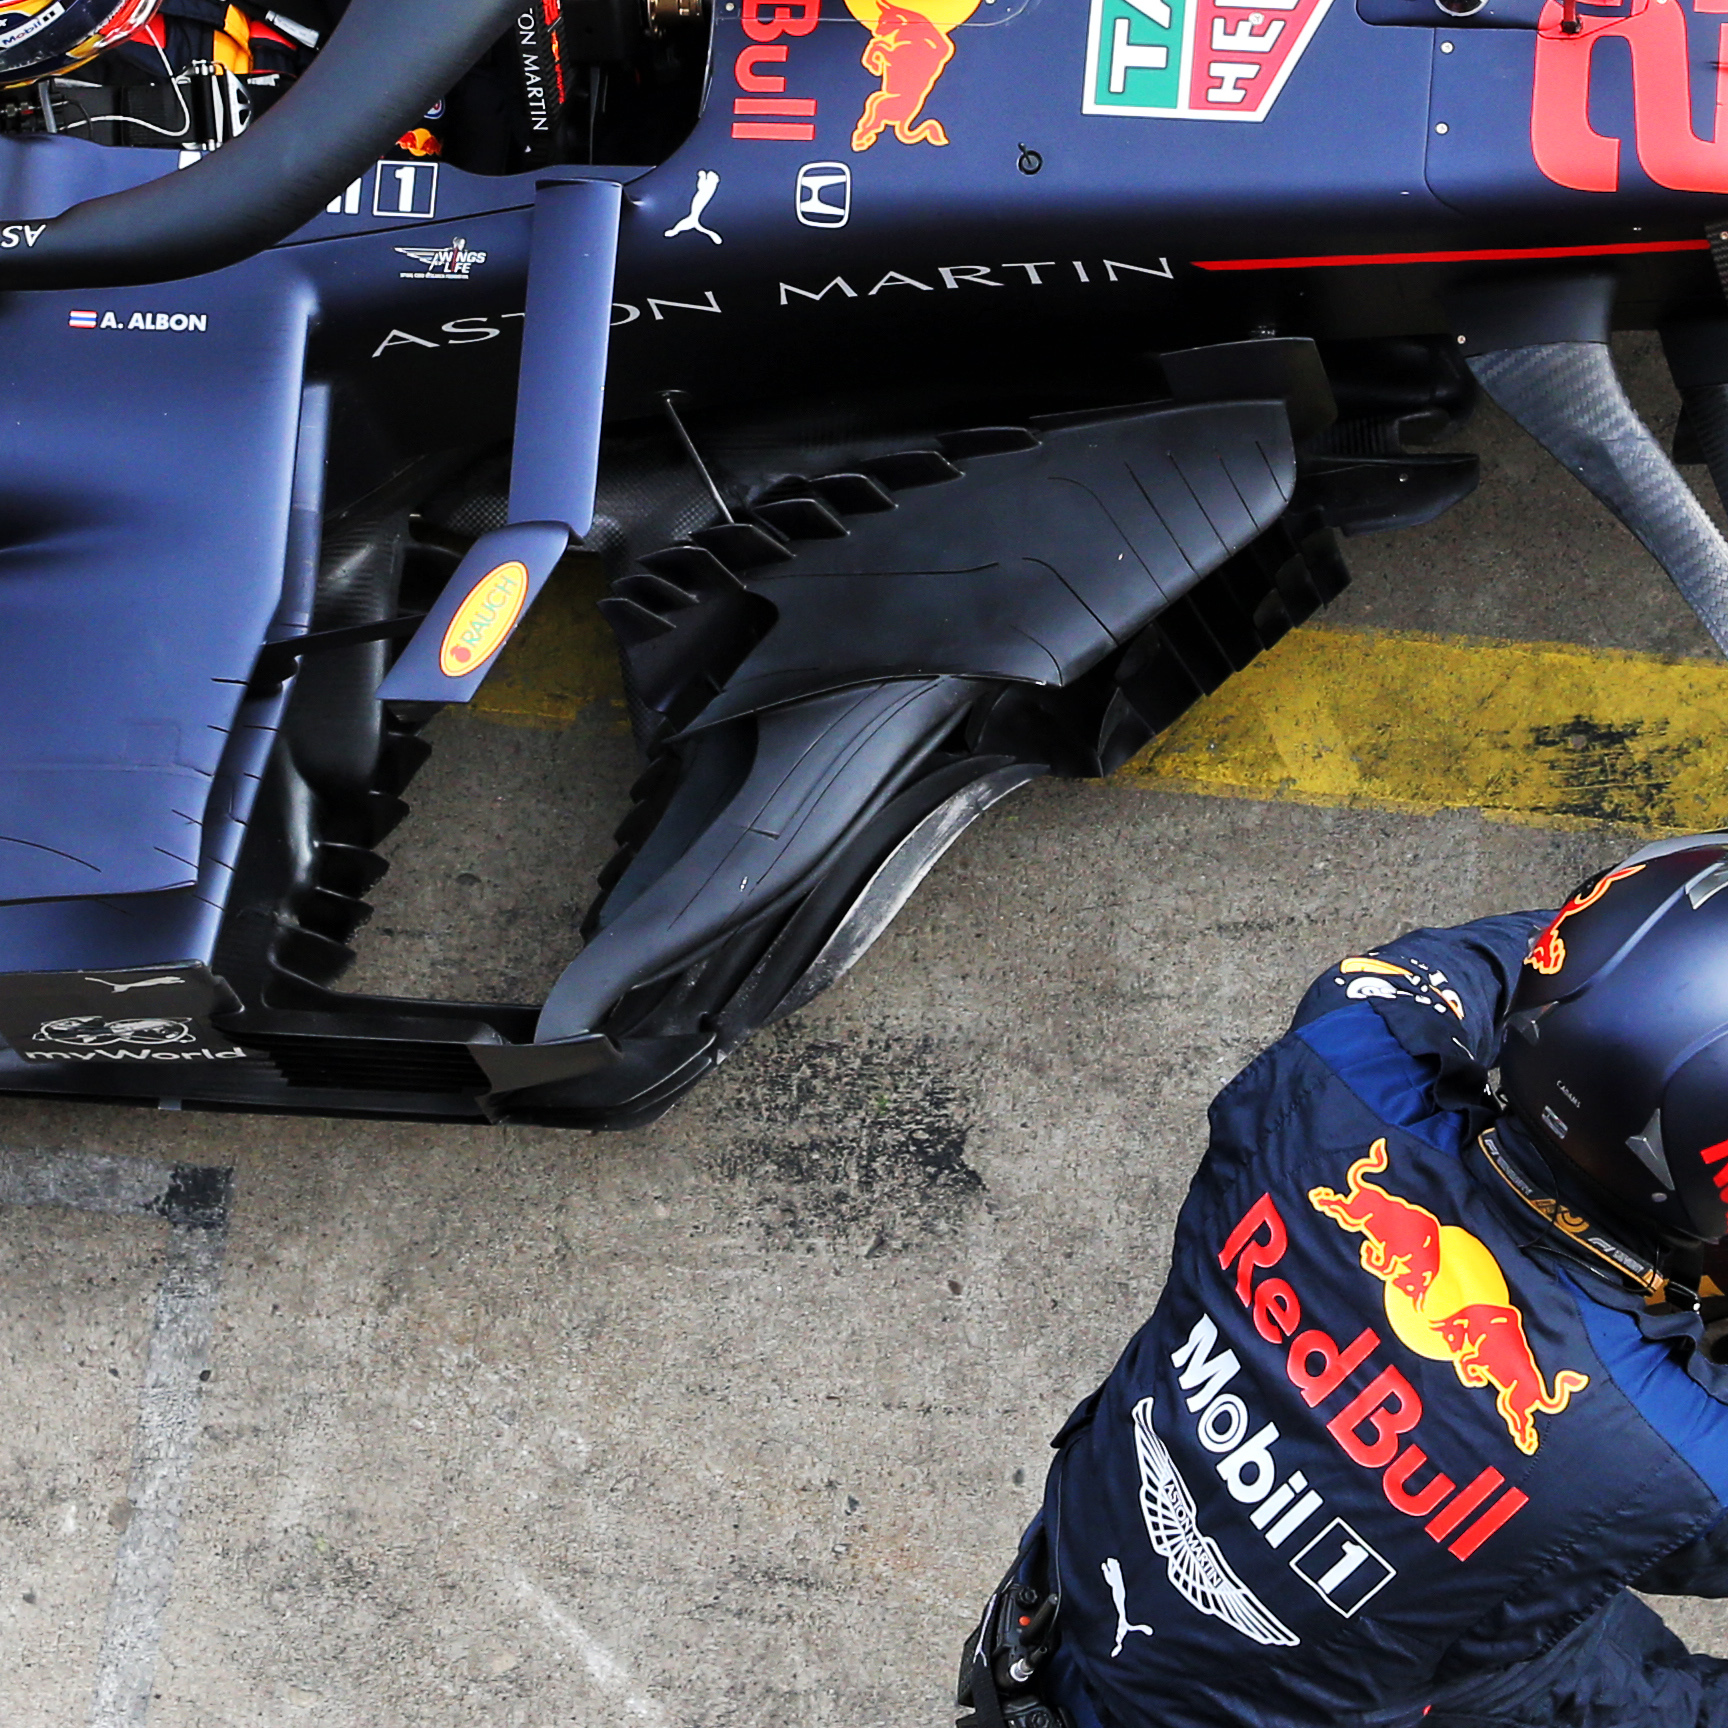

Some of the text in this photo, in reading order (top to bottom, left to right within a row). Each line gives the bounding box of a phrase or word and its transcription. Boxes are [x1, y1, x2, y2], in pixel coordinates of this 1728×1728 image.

[2, 22, 42, 46] Mobil
[522, 53, 549, 131] MARTIN
[99, 312, 208, 333] A. ALBON
[372, 257, 1175, 357] ASN MARTIN
[460, 573, 519, 650] RAUCH
[24, 1046, 247, 1064] myWorld
[1218, 1192, 1529, 1562] Red Bull
[1170, 1312, 1324, 1549] Mobil
[1163, 1482, 1224, 1589] ASTON MARTIN
